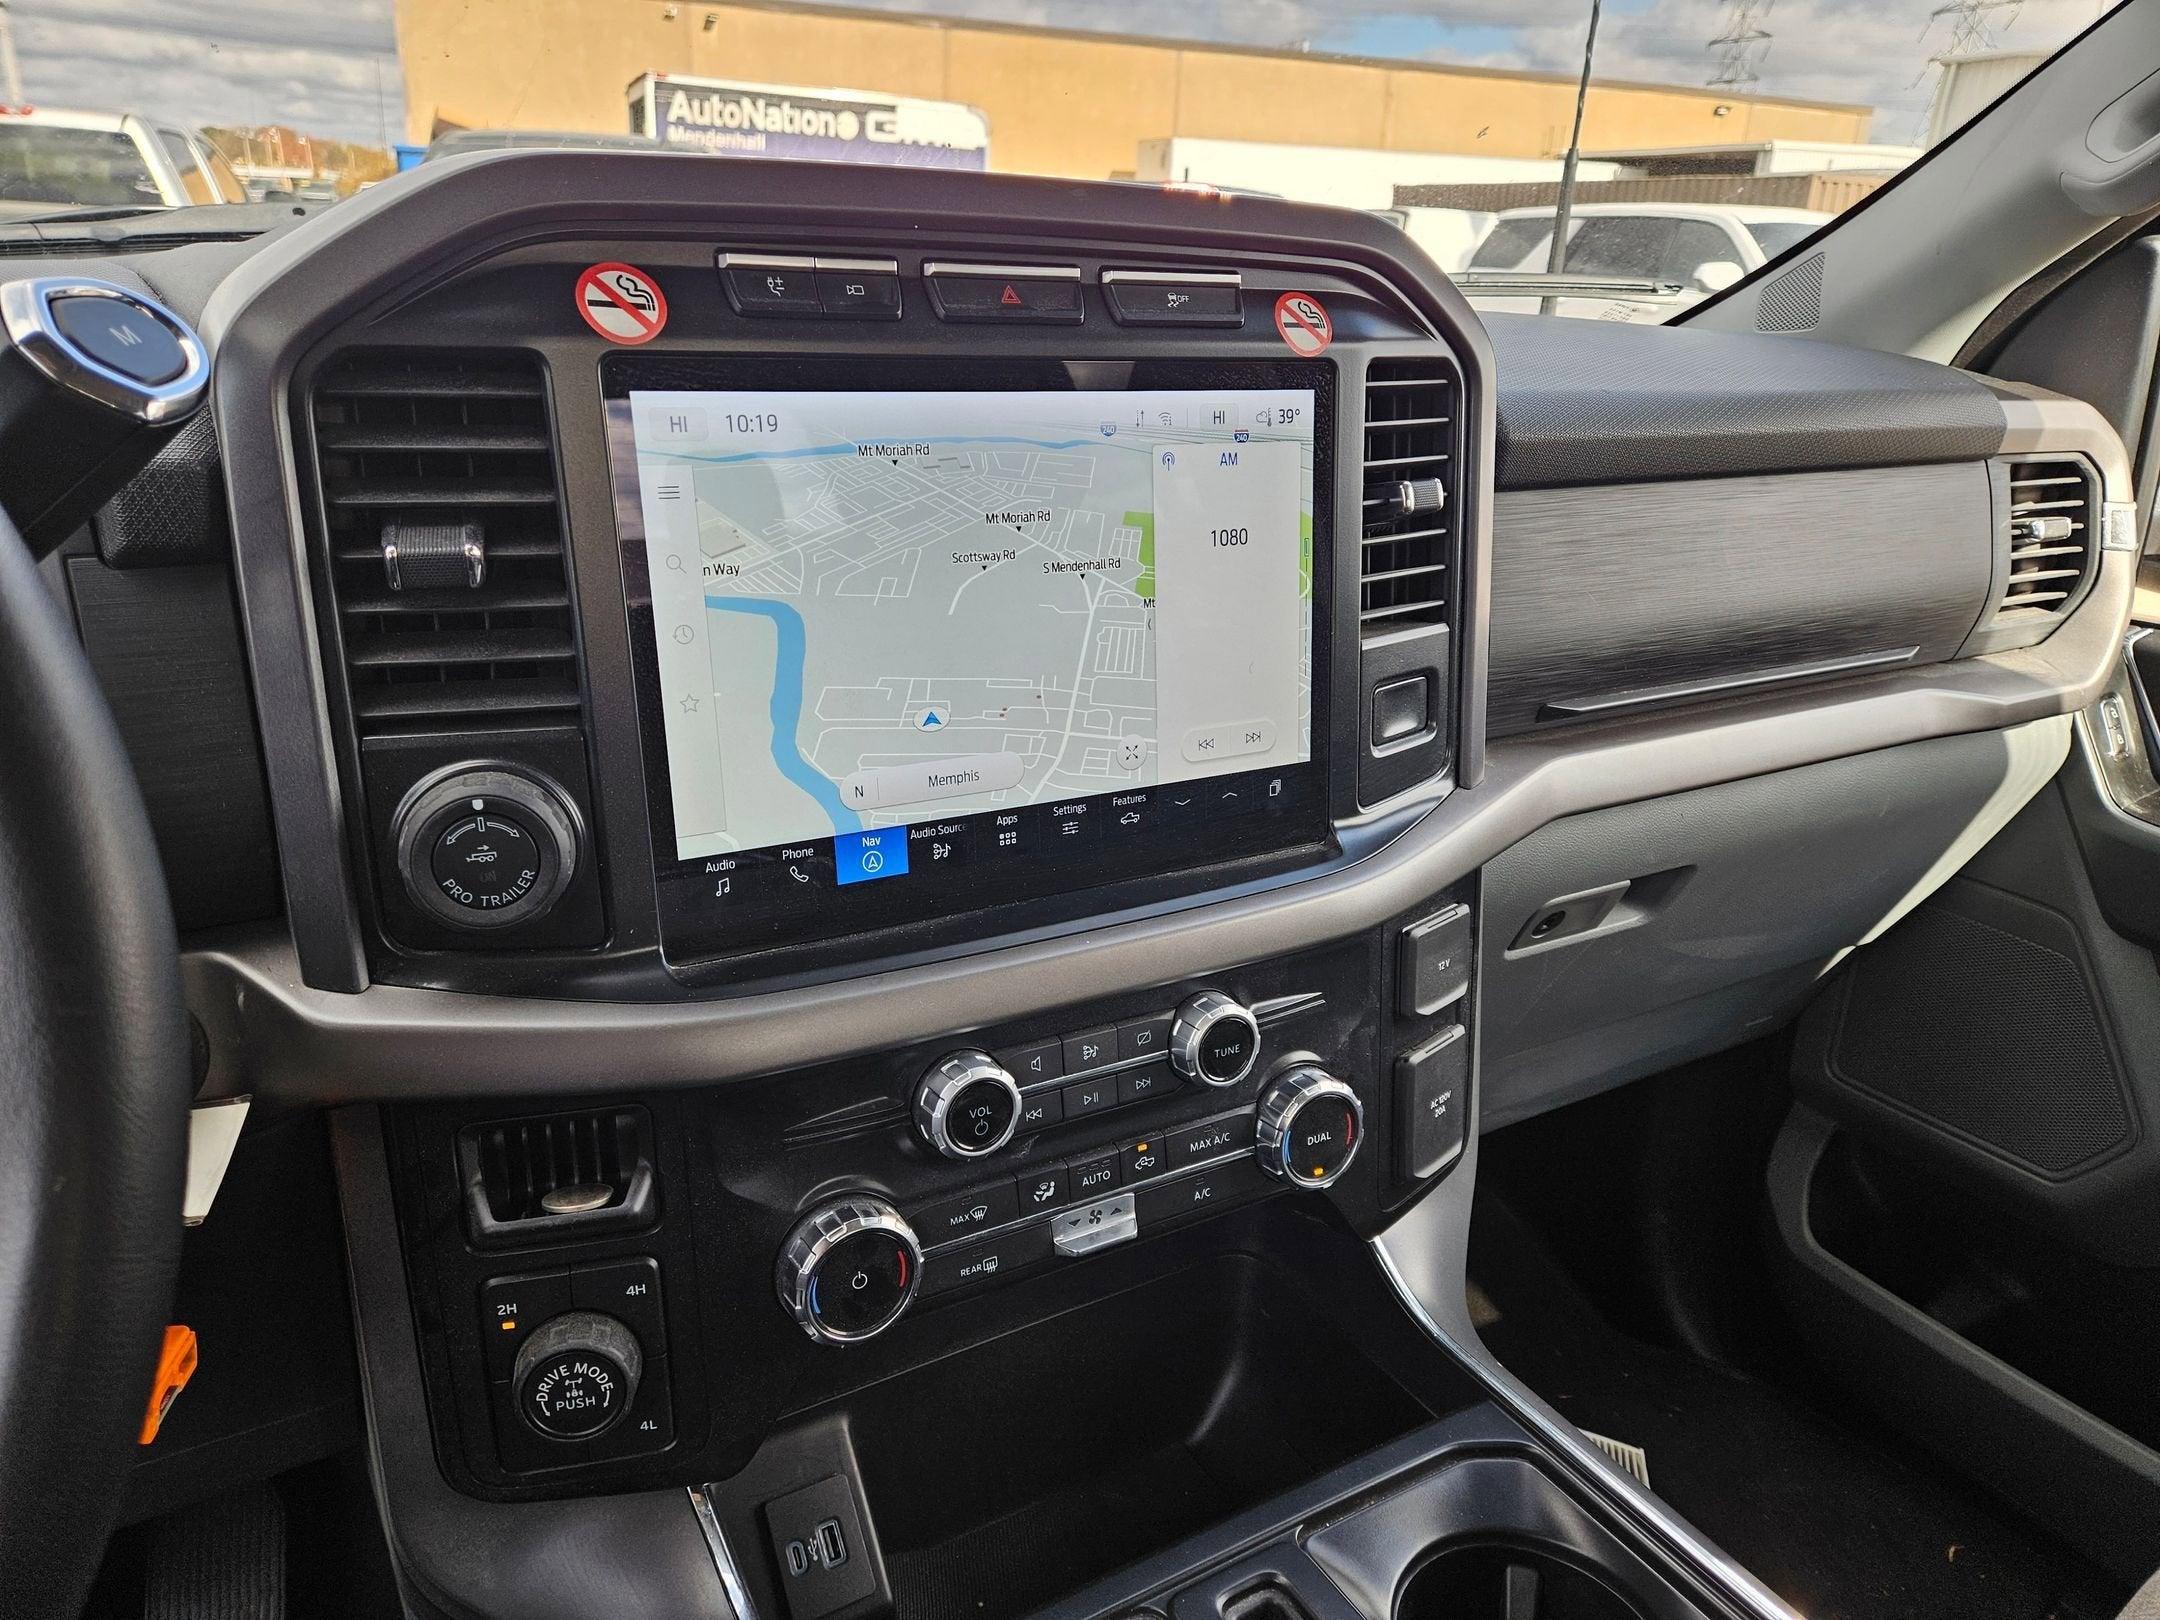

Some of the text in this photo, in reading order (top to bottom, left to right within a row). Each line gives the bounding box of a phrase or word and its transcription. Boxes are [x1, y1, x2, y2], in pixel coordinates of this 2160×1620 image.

[667, 90, 837, 137] AutoNation
[1177, 295, 1189, 303] OFF
[109, 325, 143, 346] M
[1213, 410, 1225, 424] HI
[1278, 408, 1301, 423] 39°
[670, 416, 687, 433] HI
[726, 414, 778, 433] 10:19
[1102, 426, 1115, 434] 240
[1235, 433, 1248, 442] 240
[858, 444, 930, 457] Mt Moriah Rd
[1220, 453, 1238, 466] AM
[985, 510, 1051, 524] Mt Moriah Rd
[1210, 528, 1249, 547] 1080
[951, 550, 1016, 567] Scottsway Rd
[1043, 558, 1121, 573] S Mendenhall Rd
[713, 564, 740, 576] Way
[928, 770, 980, 788] Memphis
[855, 785, 864, 797] N
[1112, 793, 1147, 806] Features
[1053, 802, 1087, 818] Settings
[996, 813, 1018, 826] Apps
[910, 826, 937, 840] Audio
[862, 836, 881, 847] Nav
[782, 846, 814, 860] Phone
[705, 859, 736, 873] Audio
[442, 869, 536, 907] PRO TRAILER
[1213, 1044, 1241, 1058] TUNE
[969, 1105, 992, 1119] VOL
[1190, 1132, 1231, 1152] MAX A/C
[1307, 1130, 1332, 1146] DUAL
[1082, 1170, 1111, 1187] AUTO
[1194, 1187, 1211, 1201] A/C
[950, 1213, 971, 1226] MAX
[960, 1264, 982, 1277] REAR
[625, 1284, 646, 1297] 4H
[497, 1303, 517, 1316] 2H
[536, 1362, 614, 1402] DRIVE MODE
[556, 1396, 596, 1411] PUSH
[640, 1419, 658, 1430] 4L
